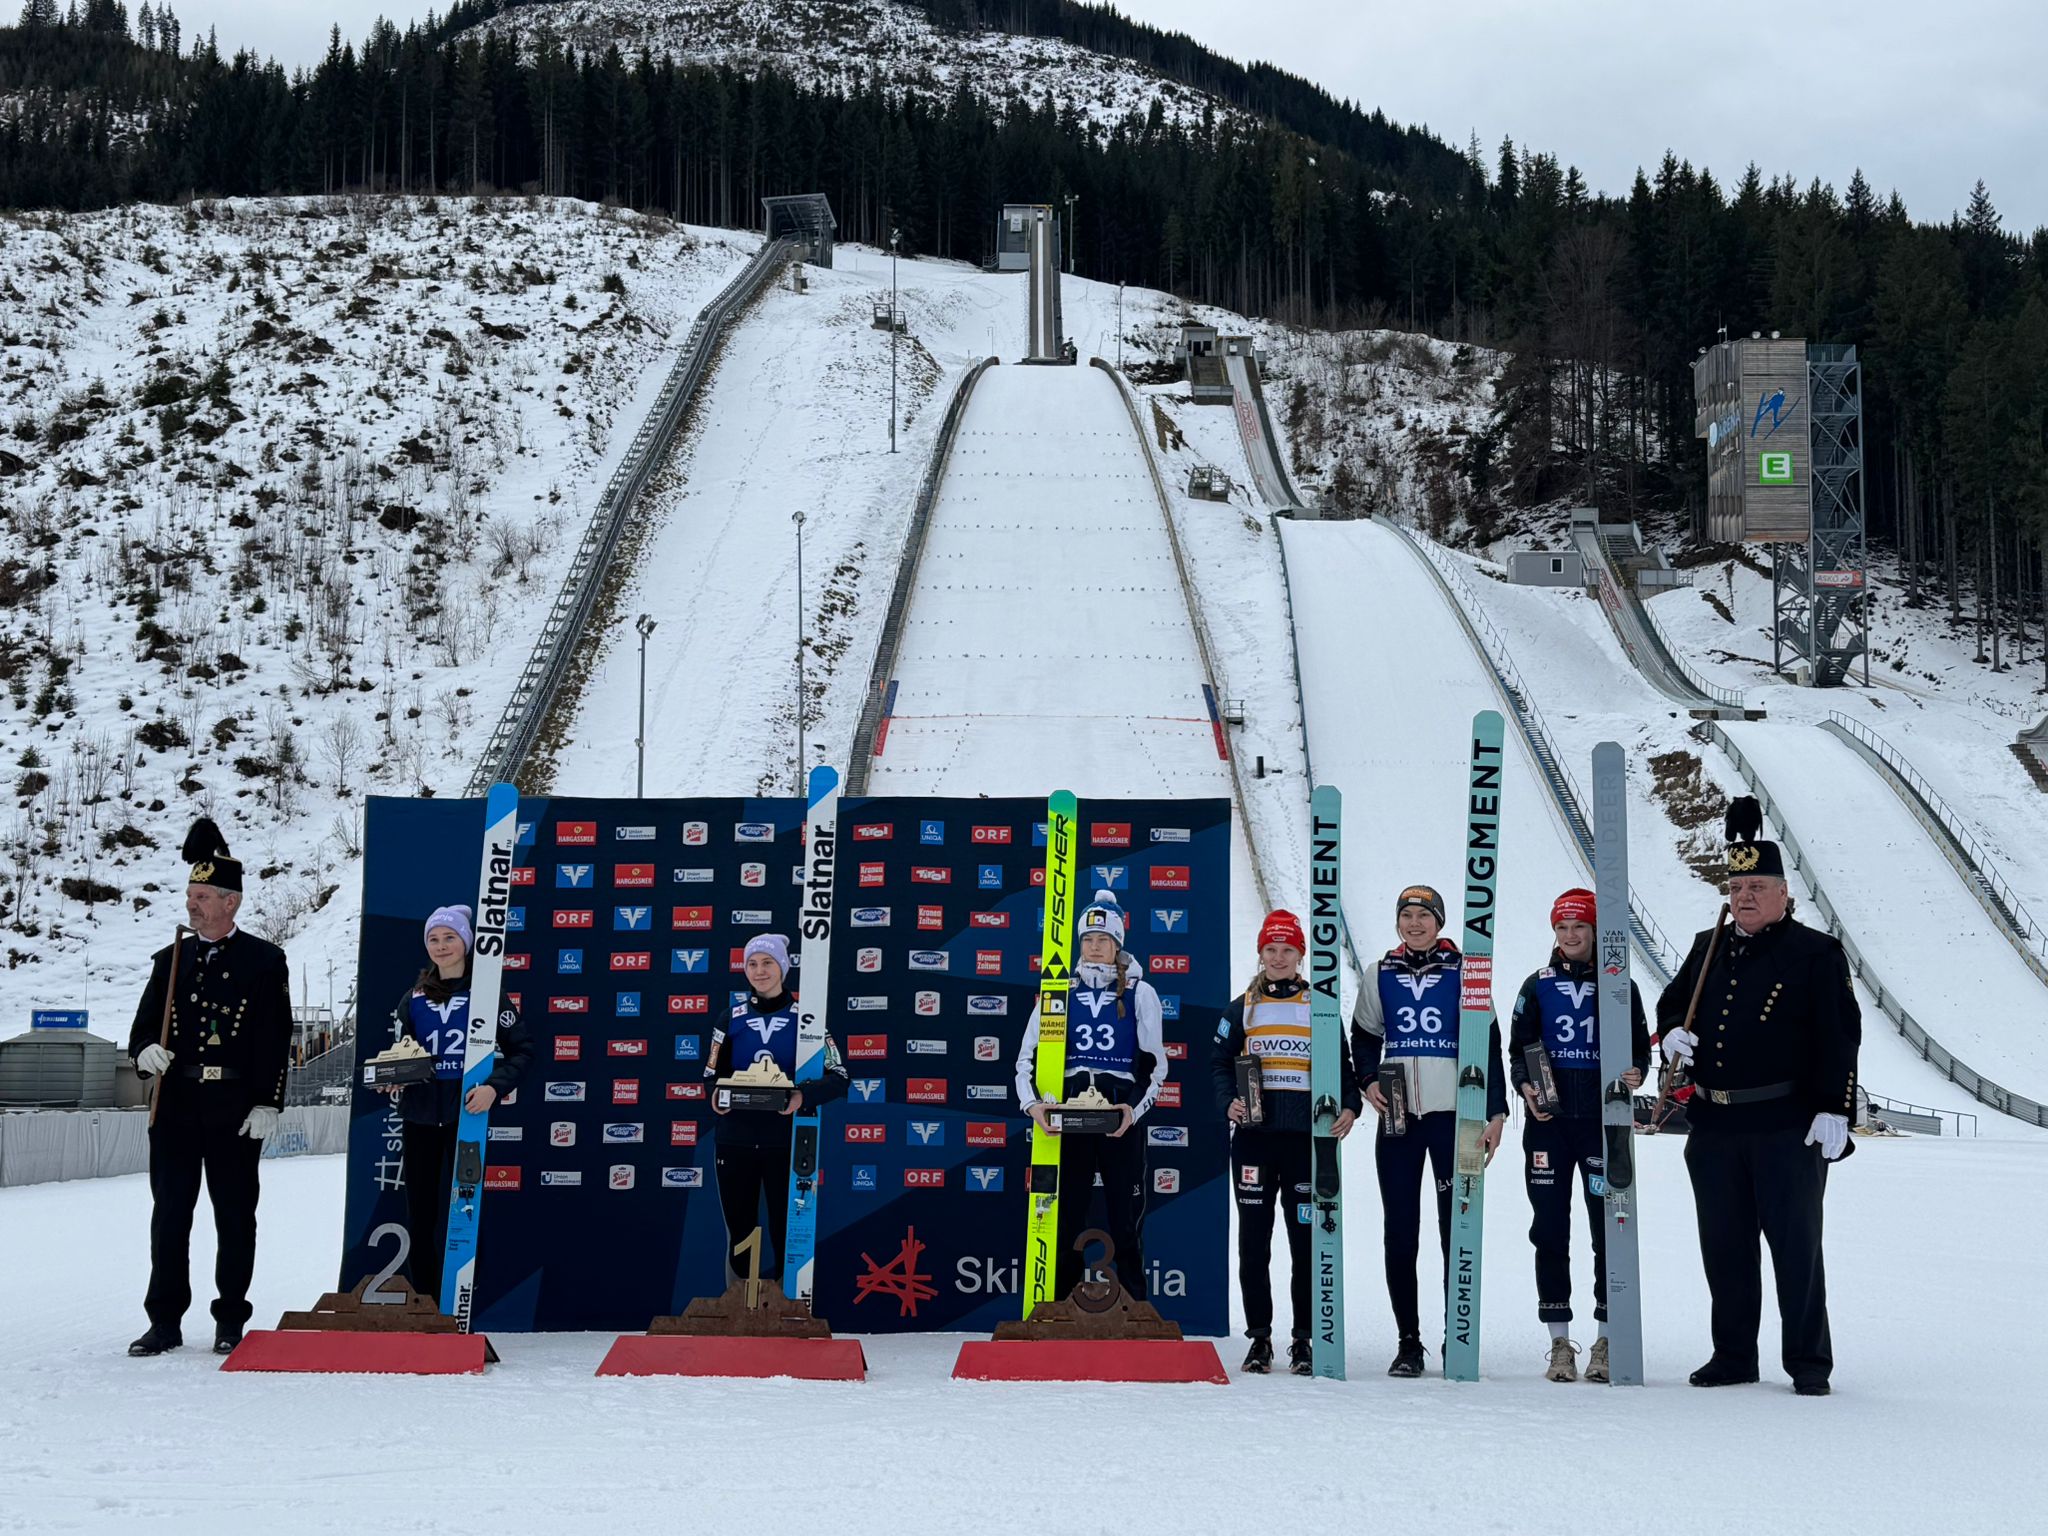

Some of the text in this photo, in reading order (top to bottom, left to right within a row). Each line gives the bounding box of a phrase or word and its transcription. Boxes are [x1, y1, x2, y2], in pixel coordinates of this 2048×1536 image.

[1767, 458, 1786, 475] E
[858, 826, 888, 837] Tirol
[975, 829, 1008, 839] ORF
[1465, 739, 1500, 939] AUGMENT
[1601, 776, 1620, 908] VAN DEER
[512, 871, 532, 881] RF
[860, 874, 883, 882] Zeitung
[916, 870, 946, 880] Tirol
[1051, 813, 1069, 947] FISCHER
[803, 824, 834, 941] Slatnar
[476, 843, 511, 957] Slatnar
[1313, 816, 1338, 999] AUGMENT
[918, 909, 942, 917] Kronen
[556, 913, 591, 924] ORF
[919, 917, 941, 926] Zeitung
[974, 914, 1004, 925] Tirol
[503, 956, 525, 967] irol
[614, 956, 647, 966] ORF
[977, 953, 1000, 961] Kronen
[977, 962, 1000, 970] Zeitung
[1152, 959, 1186, 969] ORF
[1463, 960, 1490, 968] Kronen
[1463, 970, 1491, 980] Zeitung
[1462, 986, 1490, 996] Kronen
[554, 1000, 583, 1010] Tirol
[672, 999, 706, 1009] ORF
[1462, 996, 1490, 1006] Zeitung
[1396, 1006, 1442, 1033] 36
[1556, 1015, 1594, 1044] 31
[426, 1029, 464, 1055] 12
[1076, 1024, 1115, 1050] 33
[404, 1038, 410, 1048] 2
[556, 1039, 578, 1047] Kronen
[612, 1043, 642, 1053] Tirol
[1400, 1038, 1436, 1048] zieht
[556, 1048, 578, 1056] Zeitung
[1558, 1048, 1590, 1059] zieht
[436, 1060, 458, 1070] eht
[764, 1060, 768, 1072] 1
[1263, 1075, 1302, 1083] EISENERZ
[614, 1091, 636, 1099] Zeitung
[672, 1086, 700, 1096] Tirol
[1089, 1088, 1094, 1098] 3
[848, 1128, 882, 1138] ORF
[907, 1173, 942, 1183] ORF
[361, 1223, 410, 1304] 2
[734, 1226, 762, 1309] 1
[1034, 1237, 1047, 1303] FISC
[1072, 1229, 1120, 1313] 3
[955, 1257, 1018, 1294] Ski
[1321, 1251, 1334, 1344] AUGMENT
[1456, 1247, 1472, 1345] AUGMENT
[457, 1285, 470, 1334] atnar
